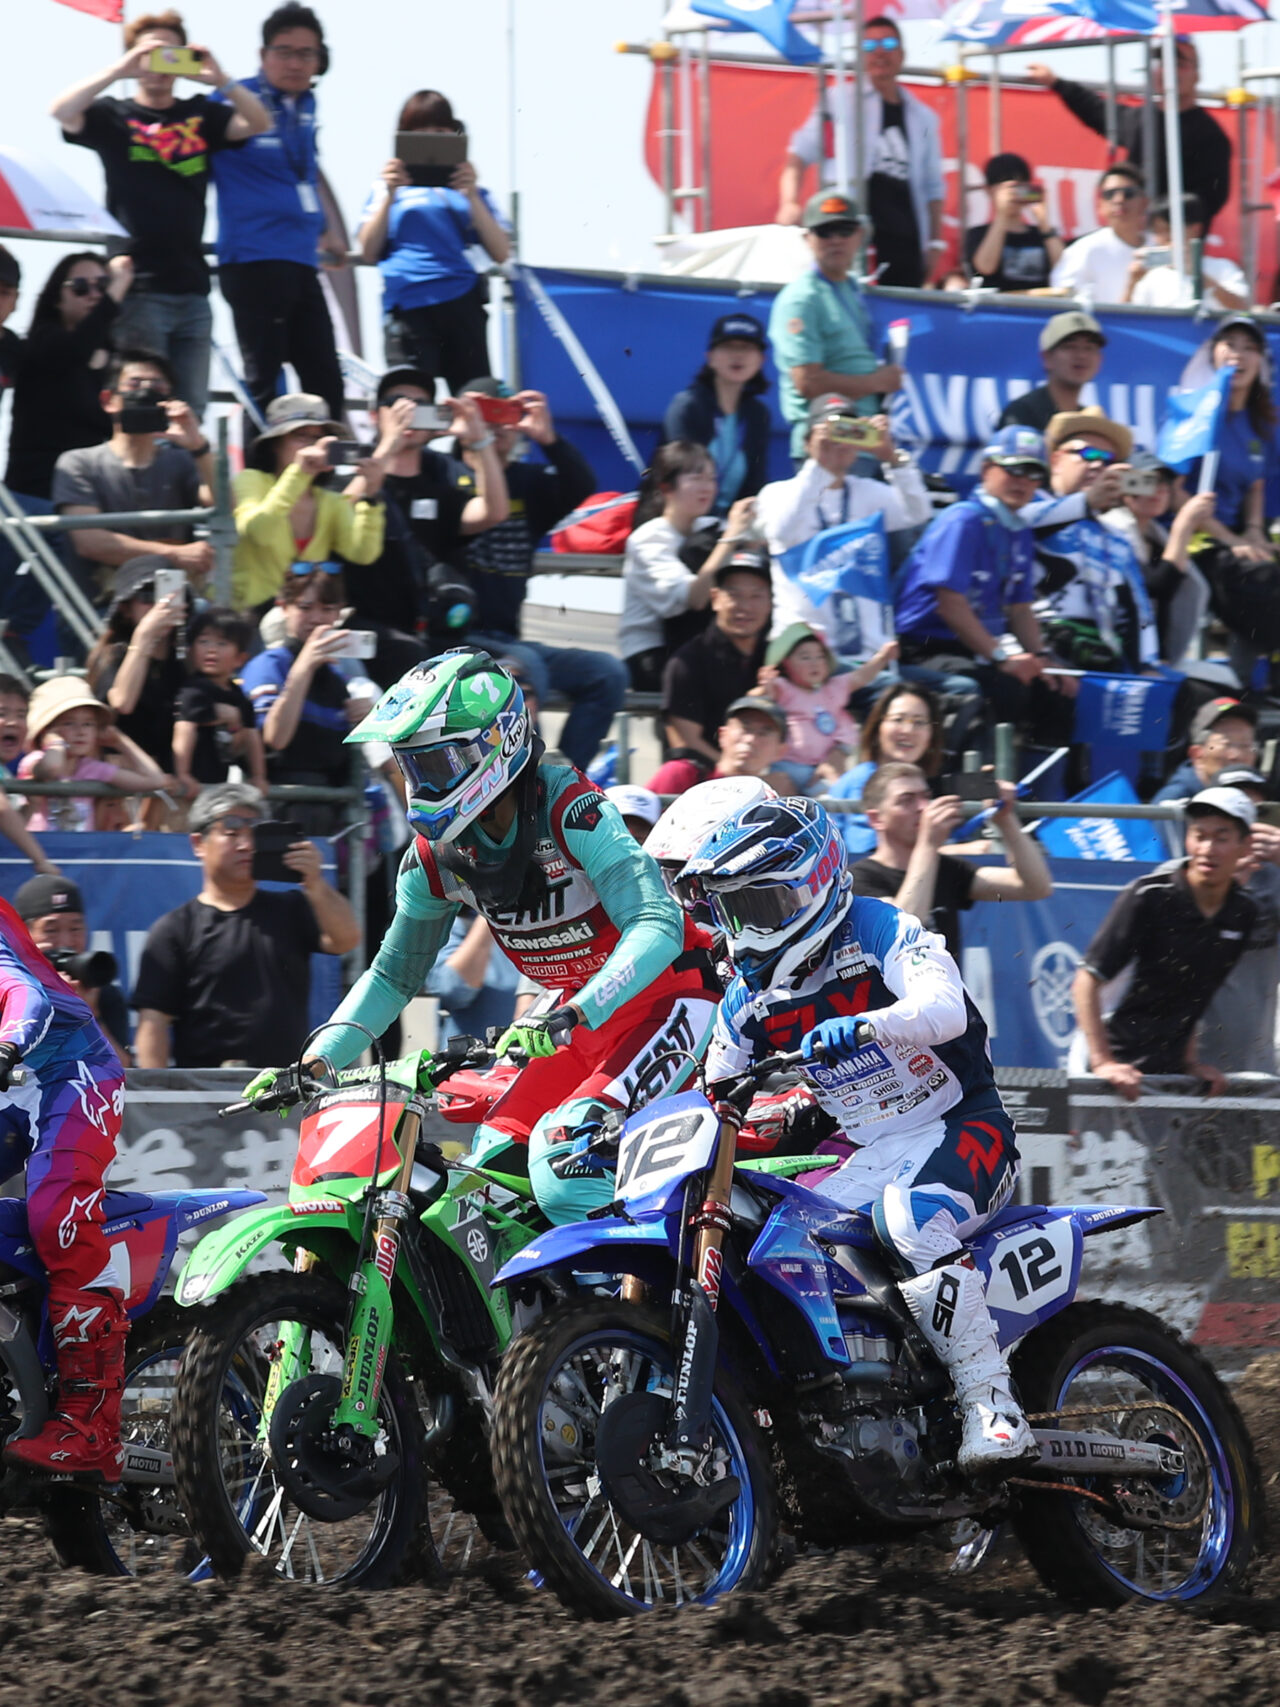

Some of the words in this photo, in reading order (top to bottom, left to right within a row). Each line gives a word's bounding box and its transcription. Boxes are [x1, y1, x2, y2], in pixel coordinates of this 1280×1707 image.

[542, 859, 568, 874] OTU
[498, 921, 595, 951] Kawasaki
[522, 964, 569, 977] SHOWA
[828, 1049, 883, 1078] YAMAHA
[874, 1081, 902, 1098] SHOEI
[309, 1105, 381, 1168] 7
[617, 1113, 704, 1192] 12
[192, 1200, 230, 1220] DUNLOP
[293, 1200, 342, 1213] MOTUL
[1093, 1207, 1127, 1222] DUNLOP
[234, 1230, 264, 1260] KAZE
[999, 1236, 1063, 1302] 12
[358, 1306, 380, 1396] DUNLOP
[1091, 1444, 1125, 1459] MOTUL
[129, 1457, 160, 1471] MOTUL
